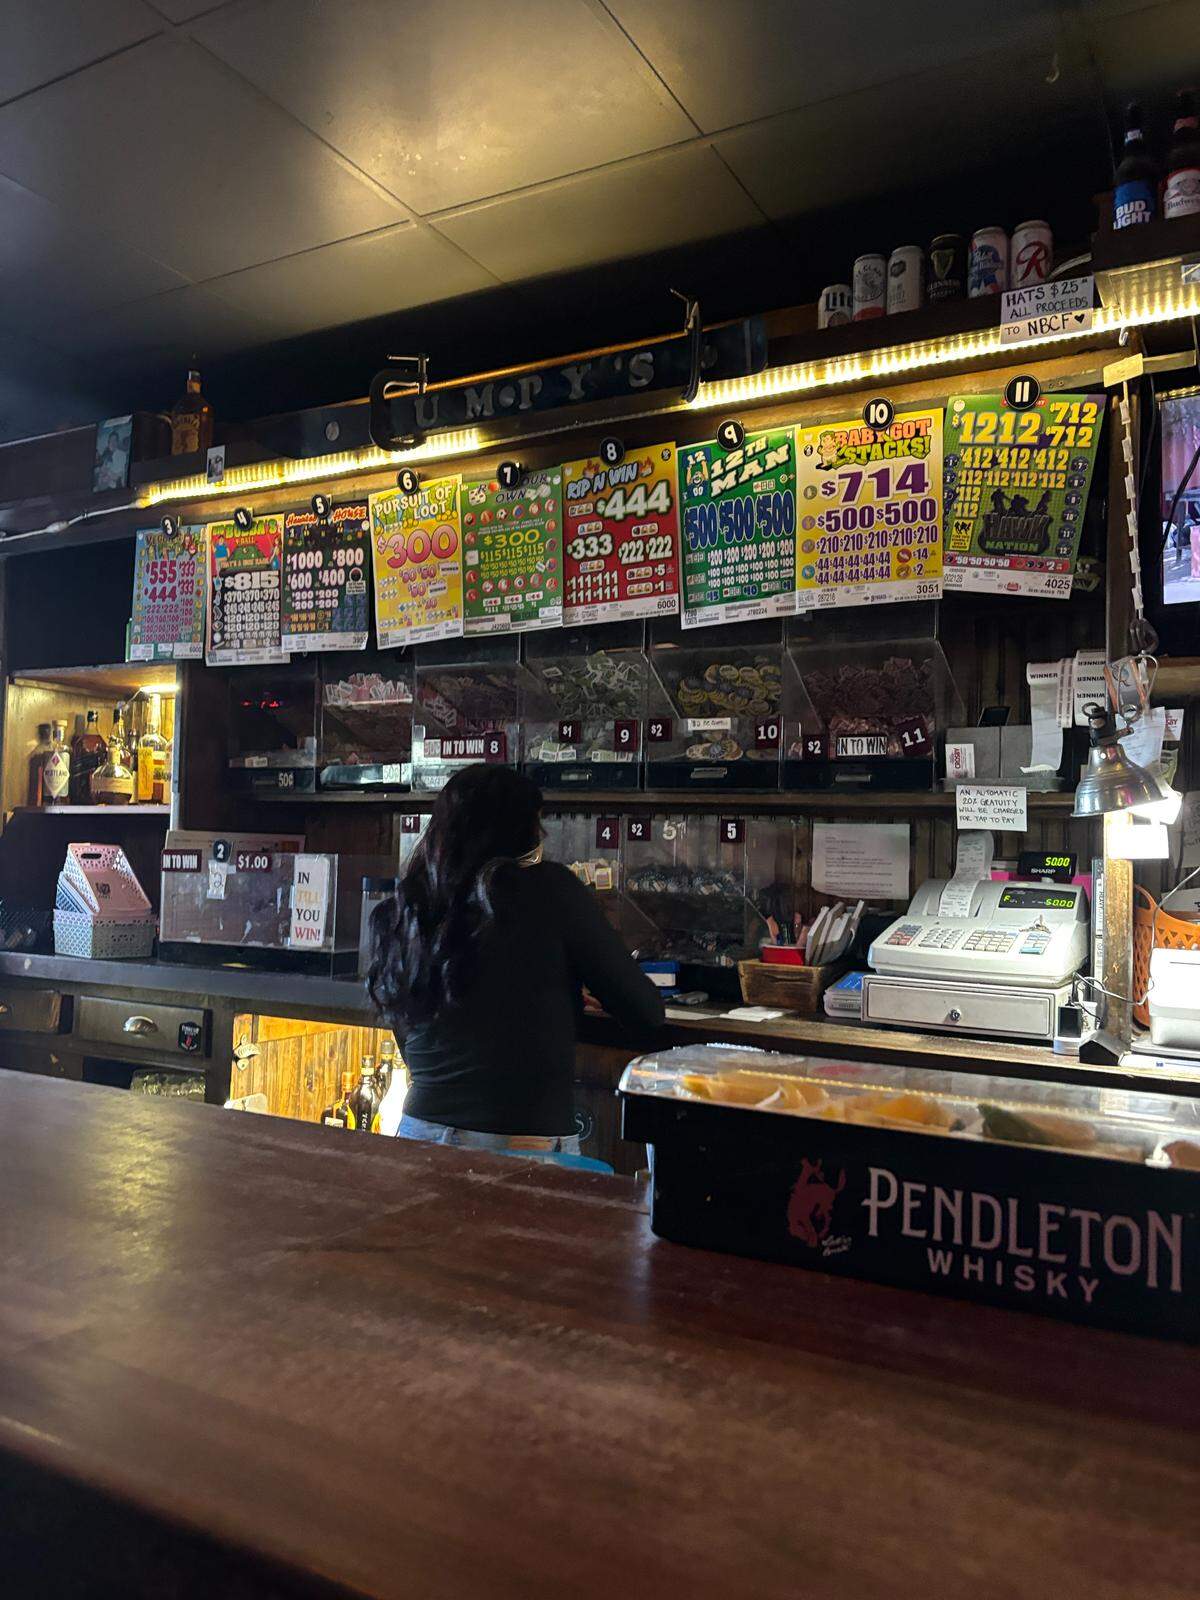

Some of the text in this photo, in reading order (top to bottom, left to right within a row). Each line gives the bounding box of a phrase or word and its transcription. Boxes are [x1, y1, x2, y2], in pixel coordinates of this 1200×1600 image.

[1115, 200, 1147, 218] BUD
[1006, 287, 1045, 307] HATS
[1010, 296, 1089, 319] ALL PROCEEDS
[1004, 312, 1073, 336] TO NBCF
[1015, 381, 1030, 403] 11
[869, 403, 889, 424] 10
[890, 418, 932, 440] GOT
[951, 403, 1098, 444] $1212 $712
[724, 424, 738, 444] 9
[1045, 426, 1092, 448] $712
[606, 443, 617, 461] 8
[687, 450, 706, 465] 12
[845, 435, 931, 463] STACKS!
[961, 448, 1069, 471] $412 $412 $412
[711, 443, 789, 498] MAN
[402, 472, 413, 490] 6
[567, 462, 639, 499] RIP N WIN
[821, 462, 930, 503] $714
[316, 496, 324, 513] 5
[375, 485, 452, 518] PURSUIT OF
[496, 489, 526, 504] OWN
[596, 480, 671, 520] $444
[237, 511, 248, 525] 4
[414, 500, 447, 520] LOOT
[817, 499, 937, 533] $500 $500
[164, 519, 173, 535] 3
[684, 489, 795, 550] $500 $500 $500
[377, 524, 458, 569] $300
[483, 529, 540, 548] $300
[567, 534, 613, 560] $333
[816, 536, 839, 554] $210
[840, 533, 863, 551] $210
[864, 530, 888, 549] $210
[889, 528, 912, 546] $210
[913, 525, 938, 544] $210
[480, 542, 544, 562] $115 $115 $115
[619, 535, 673, 564] $222 $222
[708, 539, 794, 566] $200 $200 $200 $200 $200
[913, 548, 928, 560] $14
[287, 550, 323, 570] $1000
[333, 548, 364, 567] $800
[145, 561, 177, 585] $555
[567, 563, 665, 590] $111 $111 $5
[913, 563, 923, 576] $2
[224, 571, 279, 590] $815
[288, 569, 345, 590] $600 $400
[1044, 578, 1070, 590] 4025
[144, 587, 177, 602] $444
[292, 589, 339, 600] $200 $200
[567, 580, 664, 604] $111 $111 $1
[916, 584, 939, 595] 3051
[292, 599, 339, 610] $200 $200
[657, 600, 676, 609] 6000
[562, 725, 572, 738] $1
[620, 729, 630, 743] 9
[651, 723, 663, 737] $2
[758, 725, 778, 740] 10
[901, 728, 926, 747] 11
[442, 740, 452, 755] IN
[453, 740, 464, 755] TO
[466, 739, 484, 754] WIN
[490, 740, 499, 754] 8
[808, 740, 821, 754] $2
[852, 738, 864, 754] TO
[866, 737, 887, 754] WIN
[980, 799, 1018, 807] GRATUITY
[993, 807, 1024, 815] CHARGED
[601, 826, 611, 840] 4
[631, 823, 643, 837] $2
[727, 822, 737, 840] 5
[217, 844, 225, 858] 2
[162, 854, 198, 869] IN TO WIN
[238, 855, 268, 869] $1.00
[298, 872, 310, 884] IN
[296, 908, 320, 922] YOU
[295, 927, 321, 941] WIN!
[861, 1166, 1184, 1293] PENDLETON
[926, 1246, 1100, 1304] WHISKY
